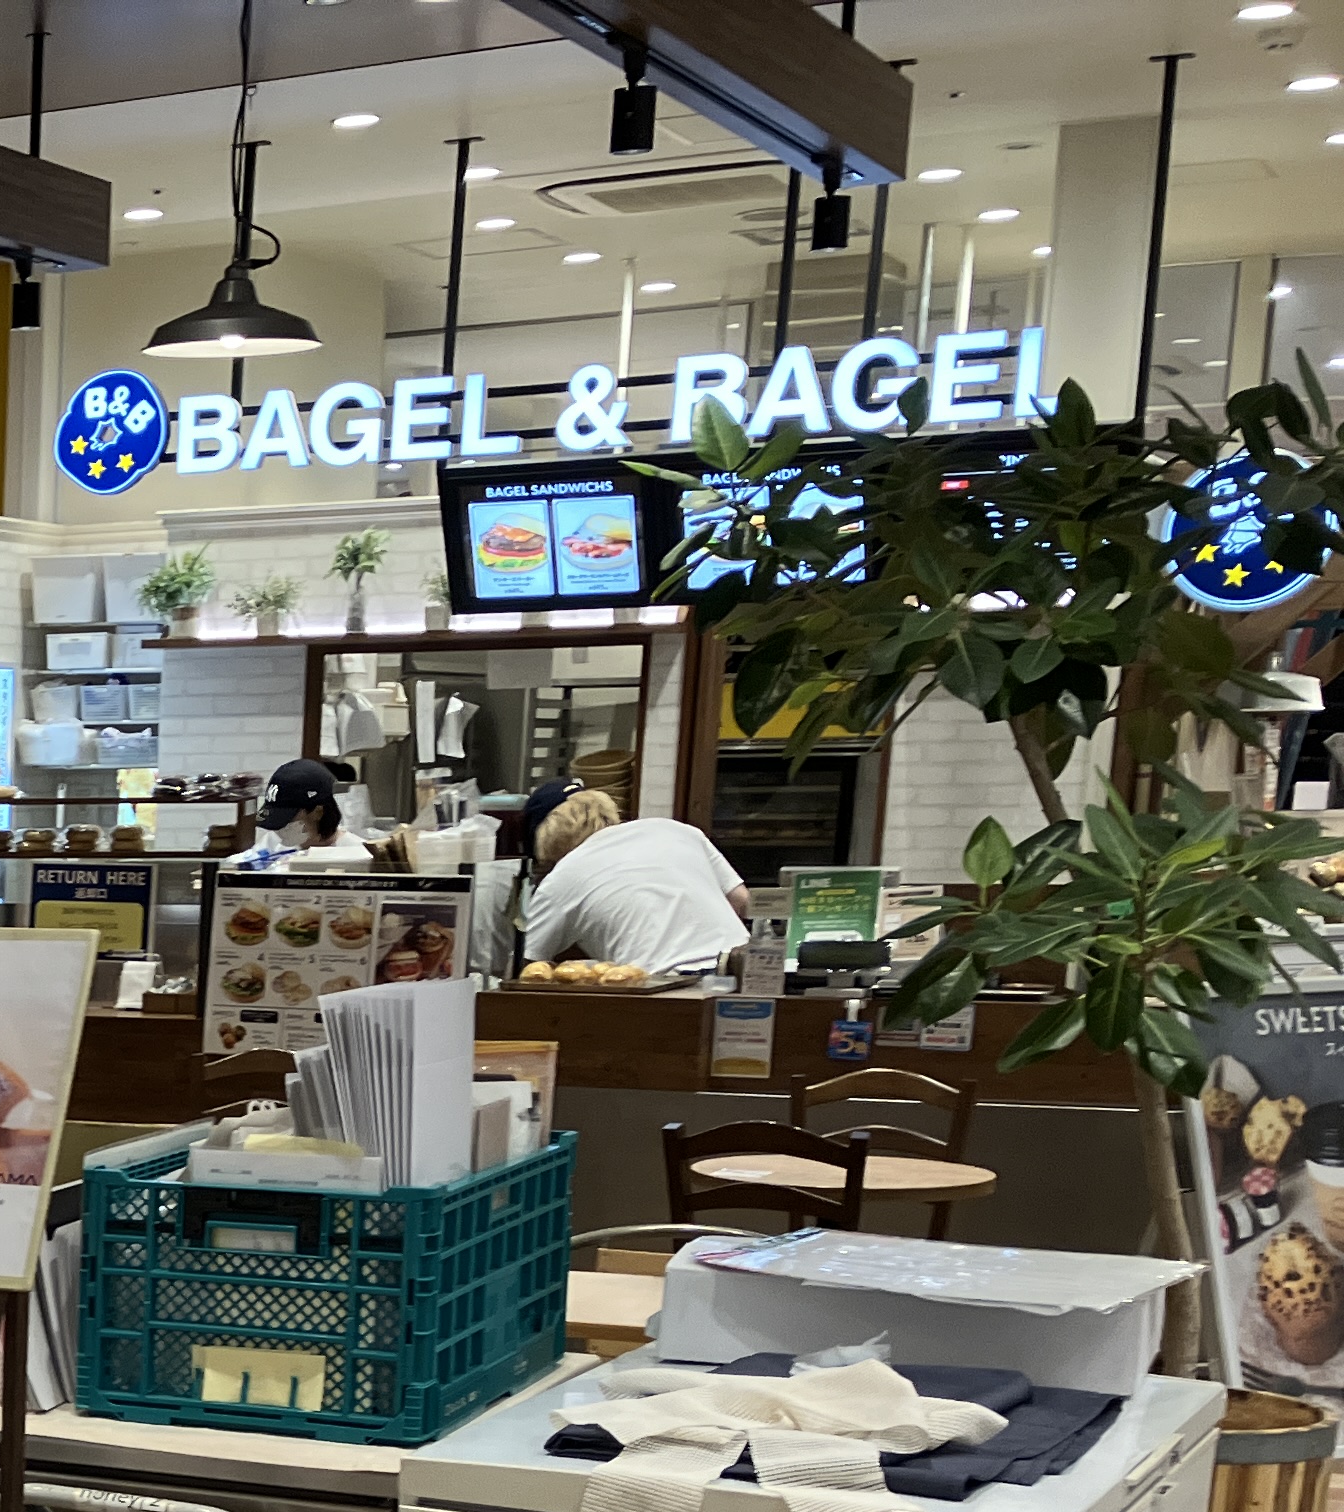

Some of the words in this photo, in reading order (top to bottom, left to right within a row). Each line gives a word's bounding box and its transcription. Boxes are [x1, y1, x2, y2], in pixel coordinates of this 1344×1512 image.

[83, 385, 155, 433] B&B
[177, 373, 521, 474] BAGEL
[555, 363, 629, 452] &
[670, 327, 1059, 444] BAGEL
[485, 486, 529, 498] BAGEL
[531, 481, 614, 496] SANDWICHS
[36, 869, 99, 885] RETURN
[106, 871, 147, 886] HERE
